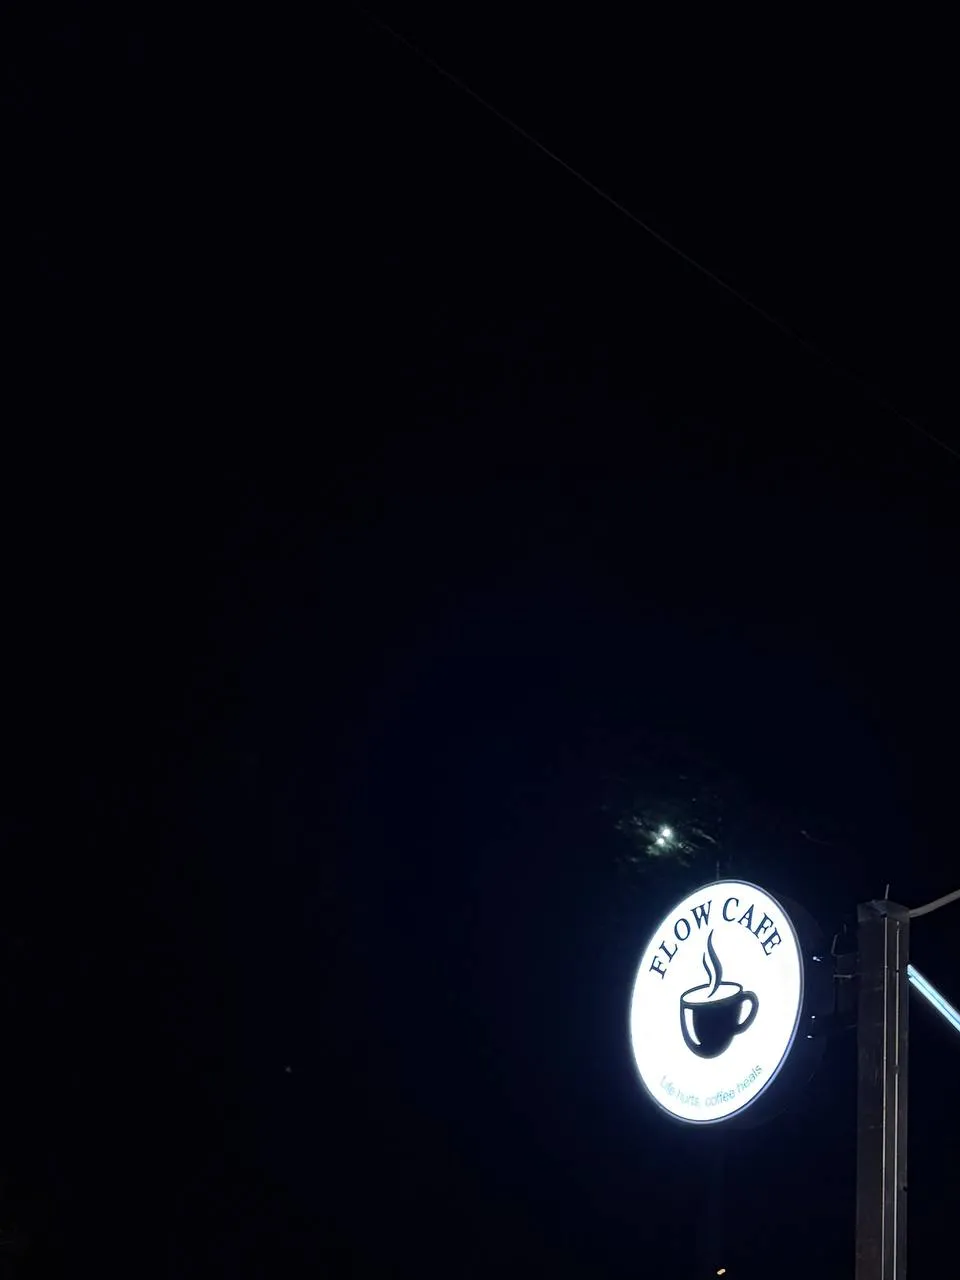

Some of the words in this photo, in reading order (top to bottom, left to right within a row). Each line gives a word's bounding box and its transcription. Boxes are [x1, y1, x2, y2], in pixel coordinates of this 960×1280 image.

[648, 899, 713, 980] FLOW
[721, 897, 783, 957] CAFE
[704, 1089, 736, 1108] coffee
[735, 1064, 763, 1094] heals
